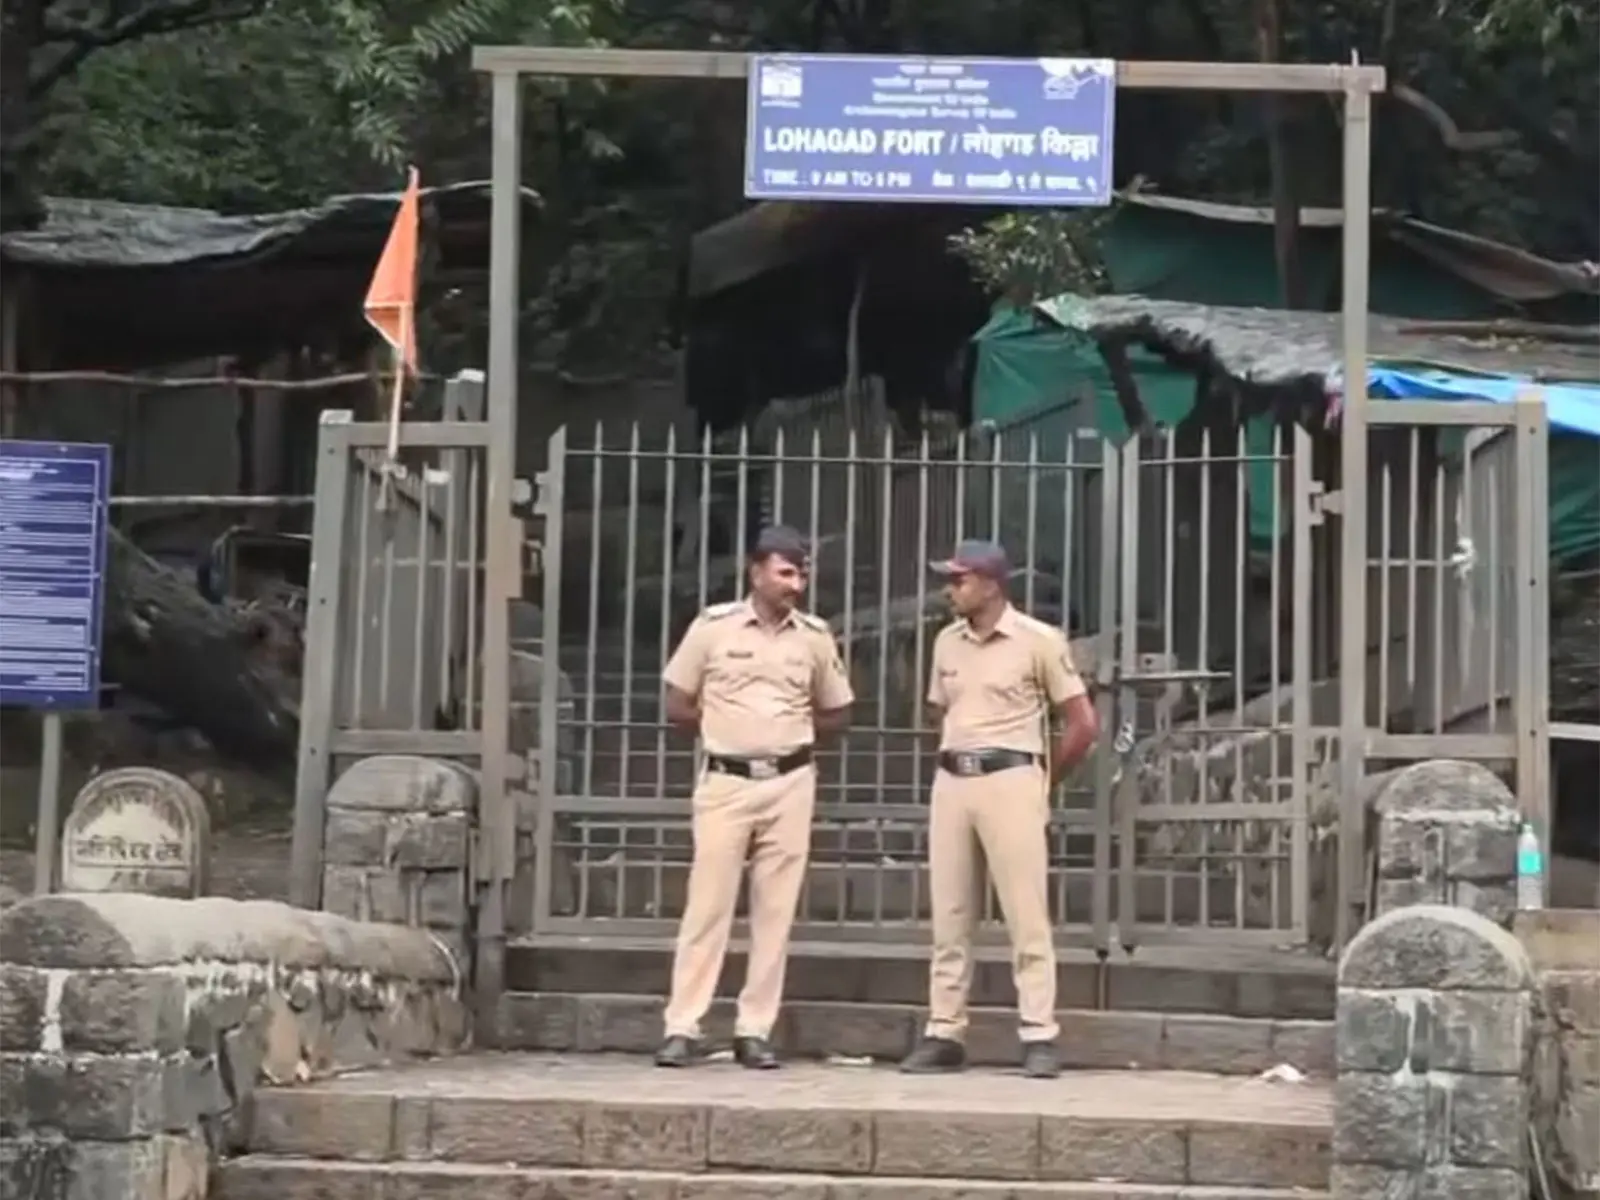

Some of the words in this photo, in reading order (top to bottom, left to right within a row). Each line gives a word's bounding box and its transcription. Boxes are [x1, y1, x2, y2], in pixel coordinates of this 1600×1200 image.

[764, 126, 877, 153] LOHAGAD
[883, 129, 945, 155] FORT
[851, 170, 873, 187] TO
